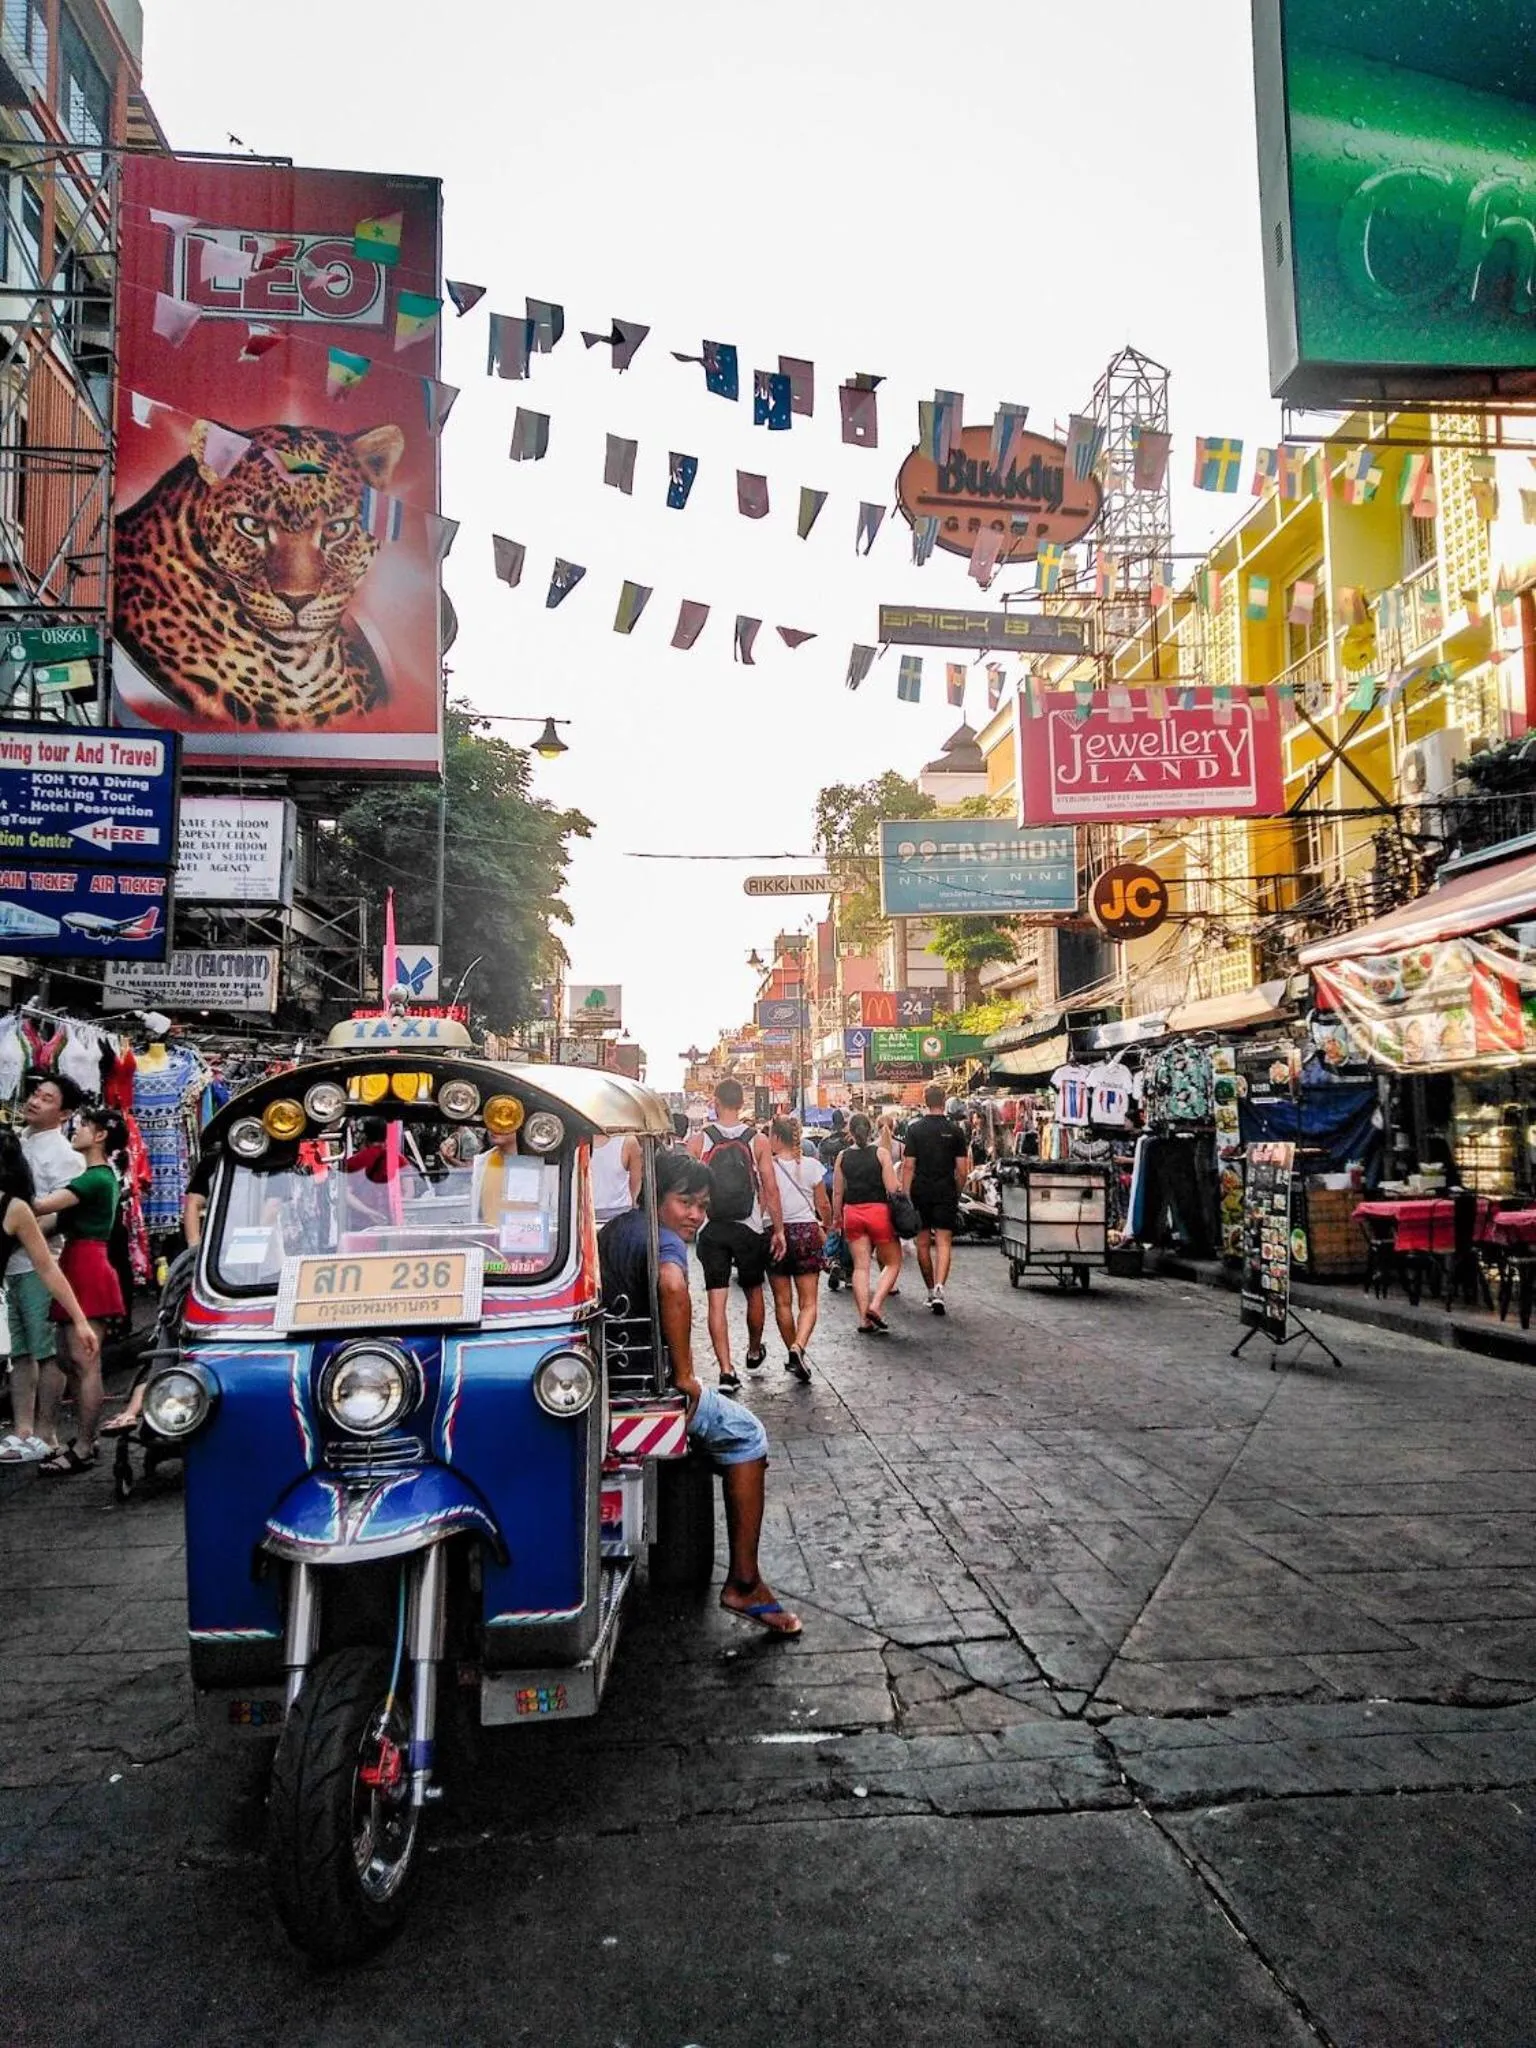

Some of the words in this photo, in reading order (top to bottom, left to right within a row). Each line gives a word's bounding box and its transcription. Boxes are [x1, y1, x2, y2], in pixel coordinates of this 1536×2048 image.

[1004, 618, 1082, 638] BR
[42, 629, 87, 644] 018661
[38, 741, 70, 762] tour
[75, 741, 104, 764] And
[110, 743, 158, 767] Travel
[1088, 759, 1220, 784] LAND
[69, 775, 100, 787] TOA
[104, 776, 150, 791] Diving
[31, 786, 95, 802] Trekking
[100, 790, 135, 803] Tour
[30, 801, 70, 813] Hotel
[236, 820, 269, 829] ROOM
[29, 831, 75, 849] Center
[92, 827, 146, 842] HERE
[227, 831, 261, 839] CLEAN
[201, 841, 231, 850] BATH
[235, 842, 268, 851] ROOM
[222, 853, 266, 861] SERVICE
[210, 864, 251, 872] AGENCY
[29, 872, 78, 892] TICKET
[90, 875, 115, 894] AIR
[118, 876, 166, 896] TICKET
[800, 879, 826, 891] INN
[899, 872, 990, 886] NINETY
[1010, 870, 1068, 882] NINE
[1101, 876, 1162, 919] JC
[196, 953, 270, 980] (FACTORY)
[352, 1020, 440, 1038] TAXI
[313, 1262, 362, 1294] สก
[391, 1261, 451, 1290] 236
[318, 1299, 440, 1321] กรุงเทพมหานคร
